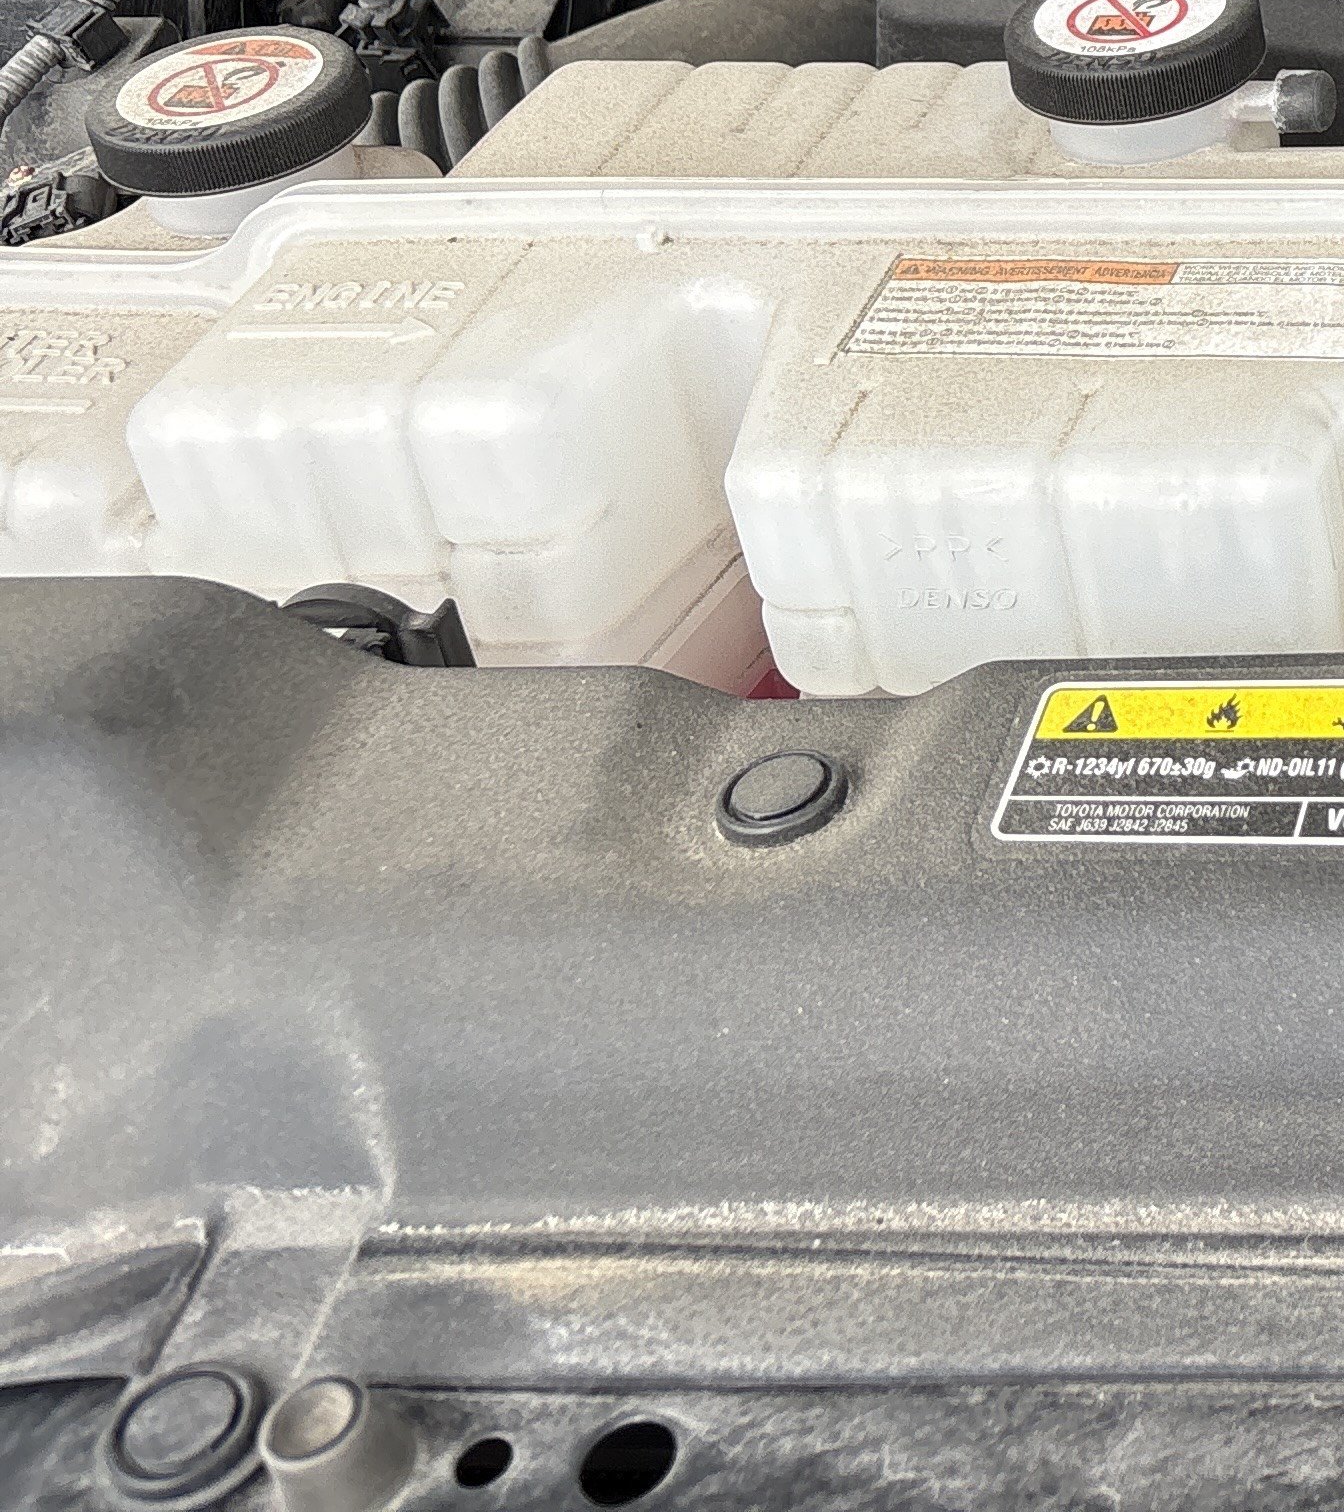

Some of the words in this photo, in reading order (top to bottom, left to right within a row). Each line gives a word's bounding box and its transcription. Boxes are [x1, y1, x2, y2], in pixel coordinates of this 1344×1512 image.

[1080, 45, 1136, 53] 108kPa
[253, 281, 467, 311] ENGINE
[898, 587, 1018, 610] DENSO
[1051, 757, 1136, 779] R-1234yf
[1054, 804, 1104, 817] TOYOTA
[1106, 804, 1154, 818] MOTOR
[1157, 804, 1251, 819] CORPORATION
[1048, 818, 1075, 831] SAE
[1075, 819, 1108, 832] J639
[1108, 819, 1149, 832] J2842
[1150, 819, 1189, 833] J2845
